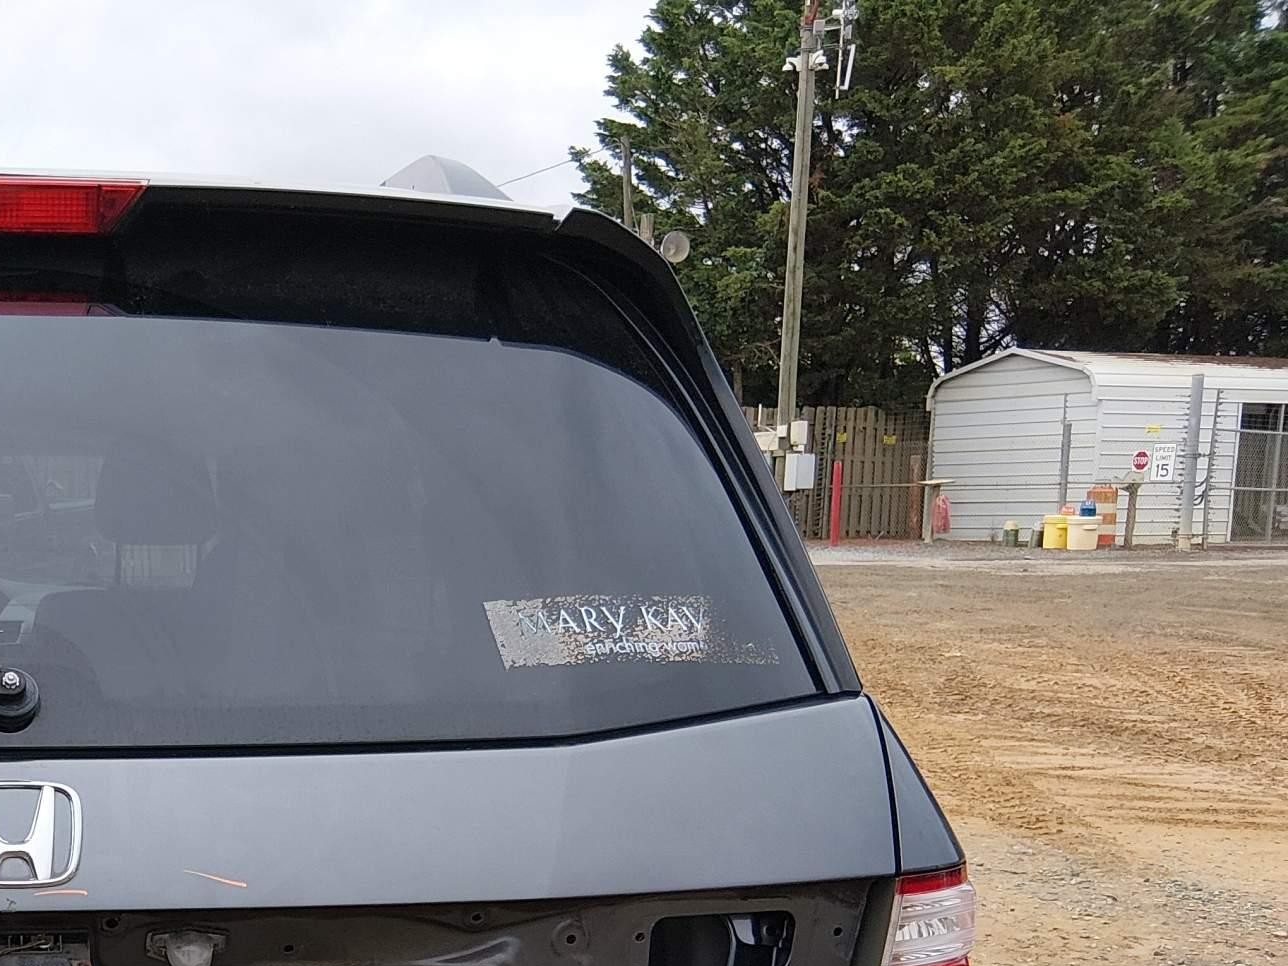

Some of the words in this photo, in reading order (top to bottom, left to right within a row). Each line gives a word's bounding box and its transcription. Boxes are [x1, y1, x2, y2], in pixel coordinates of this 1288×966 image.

[1133, 456, 1148, 465] STOP
[1155, 463, 1169, 478] 15
[518, 605, 626, 639] MARY
[640, 605, 705, 633] KAY
